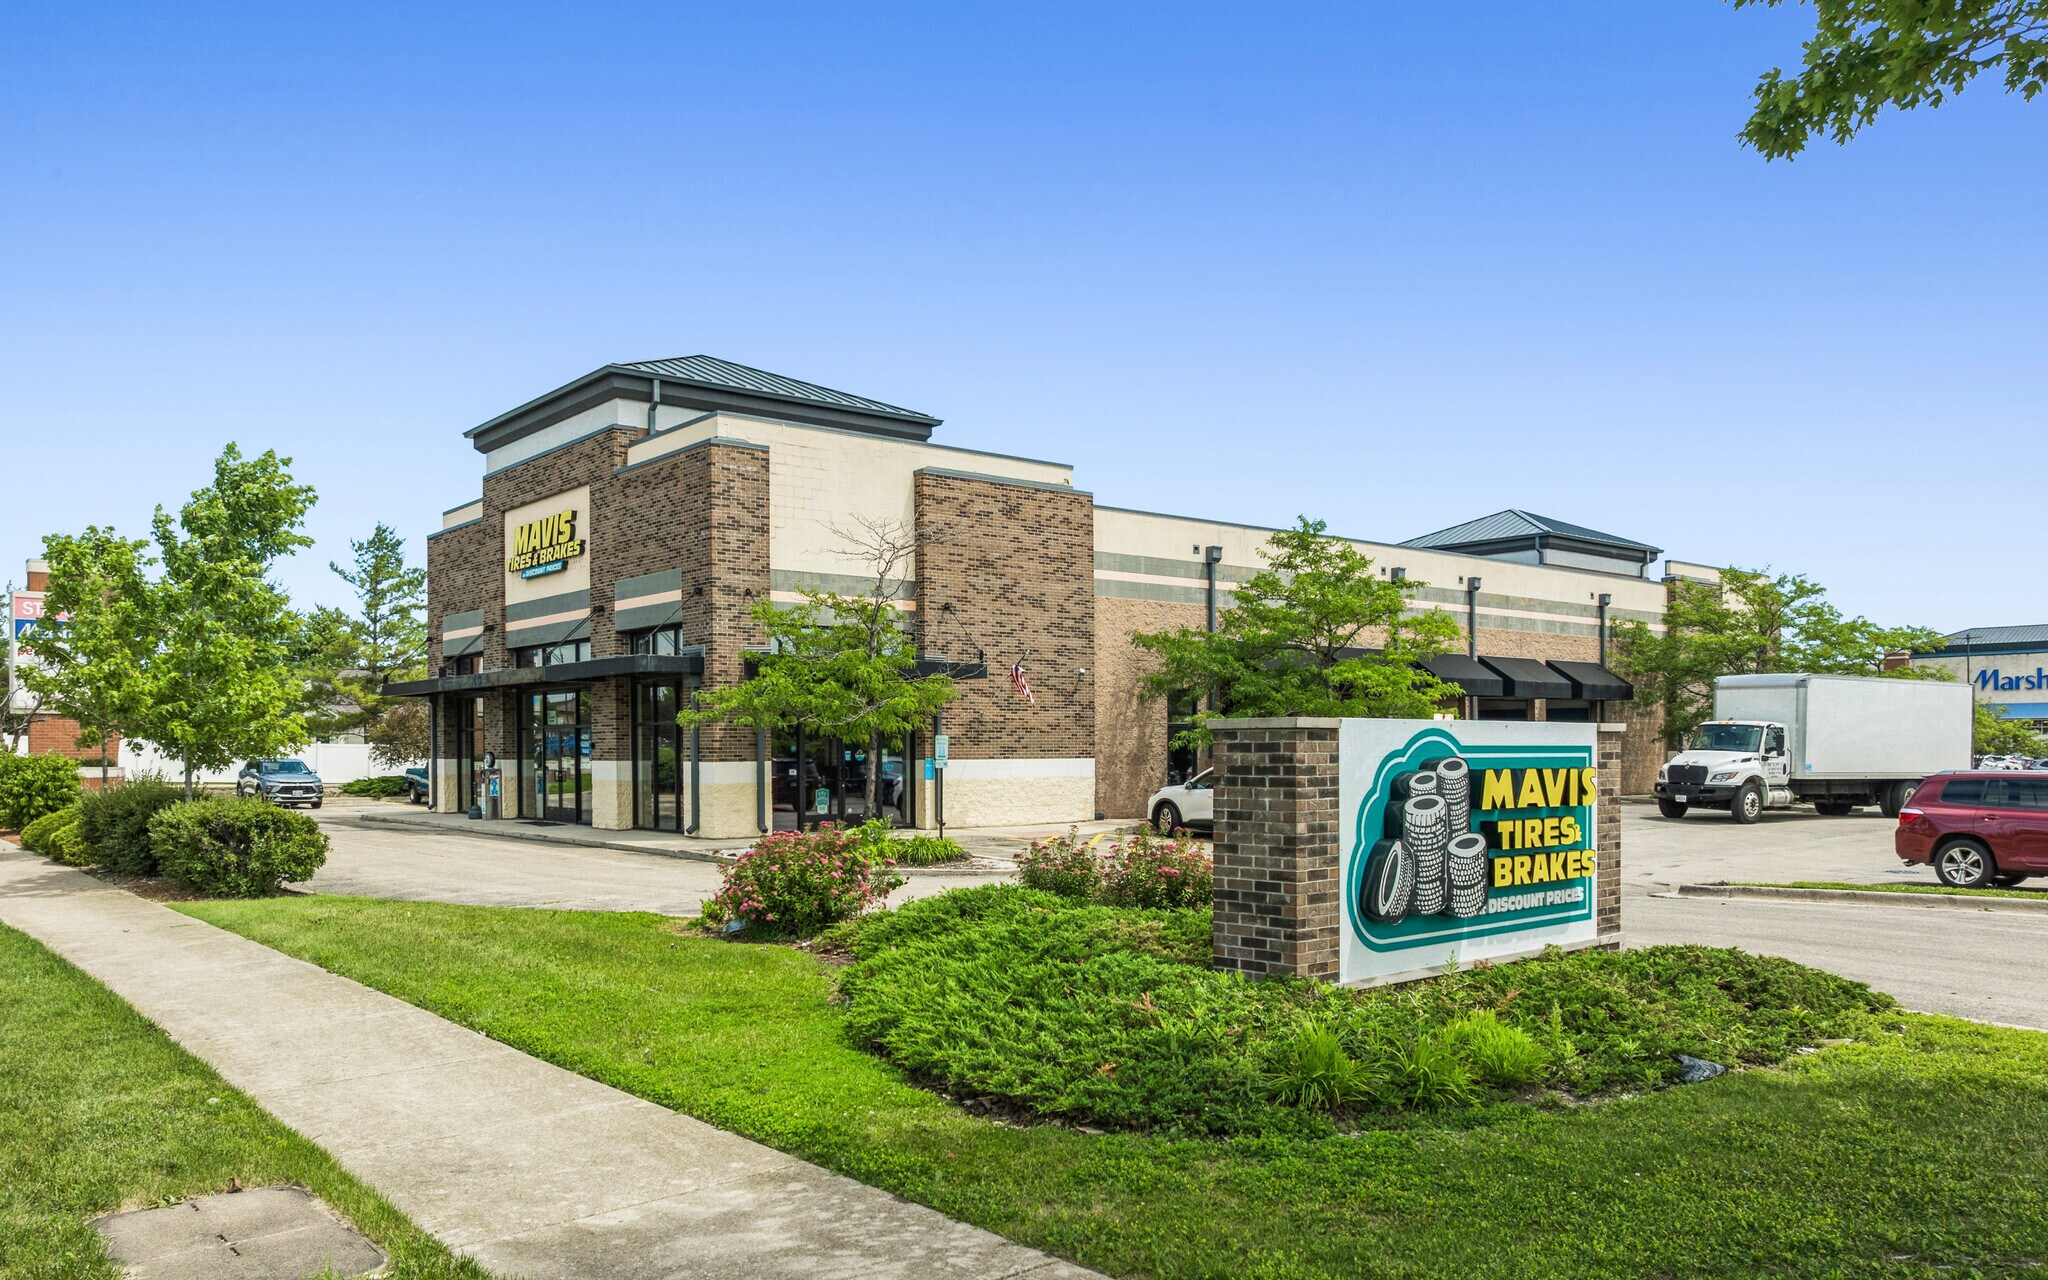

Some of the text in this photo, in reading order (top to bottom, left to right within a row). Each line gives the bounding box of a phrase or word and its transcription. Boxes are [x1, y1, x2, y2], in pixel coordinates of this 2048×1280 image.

[513, 509, 574, 556] MAVIS
[506, 539, 581, 572] TIRES & BRAKES
[1481, 767, 1597, 811] MAVIS
[1497, 816, 1576, 850] TIRES
[1494, 849, 1596, 888] BRAKES
[1488, 894, 1545, 914] DISCOUNT
[1546, 886, 1584, 906] PRICES
